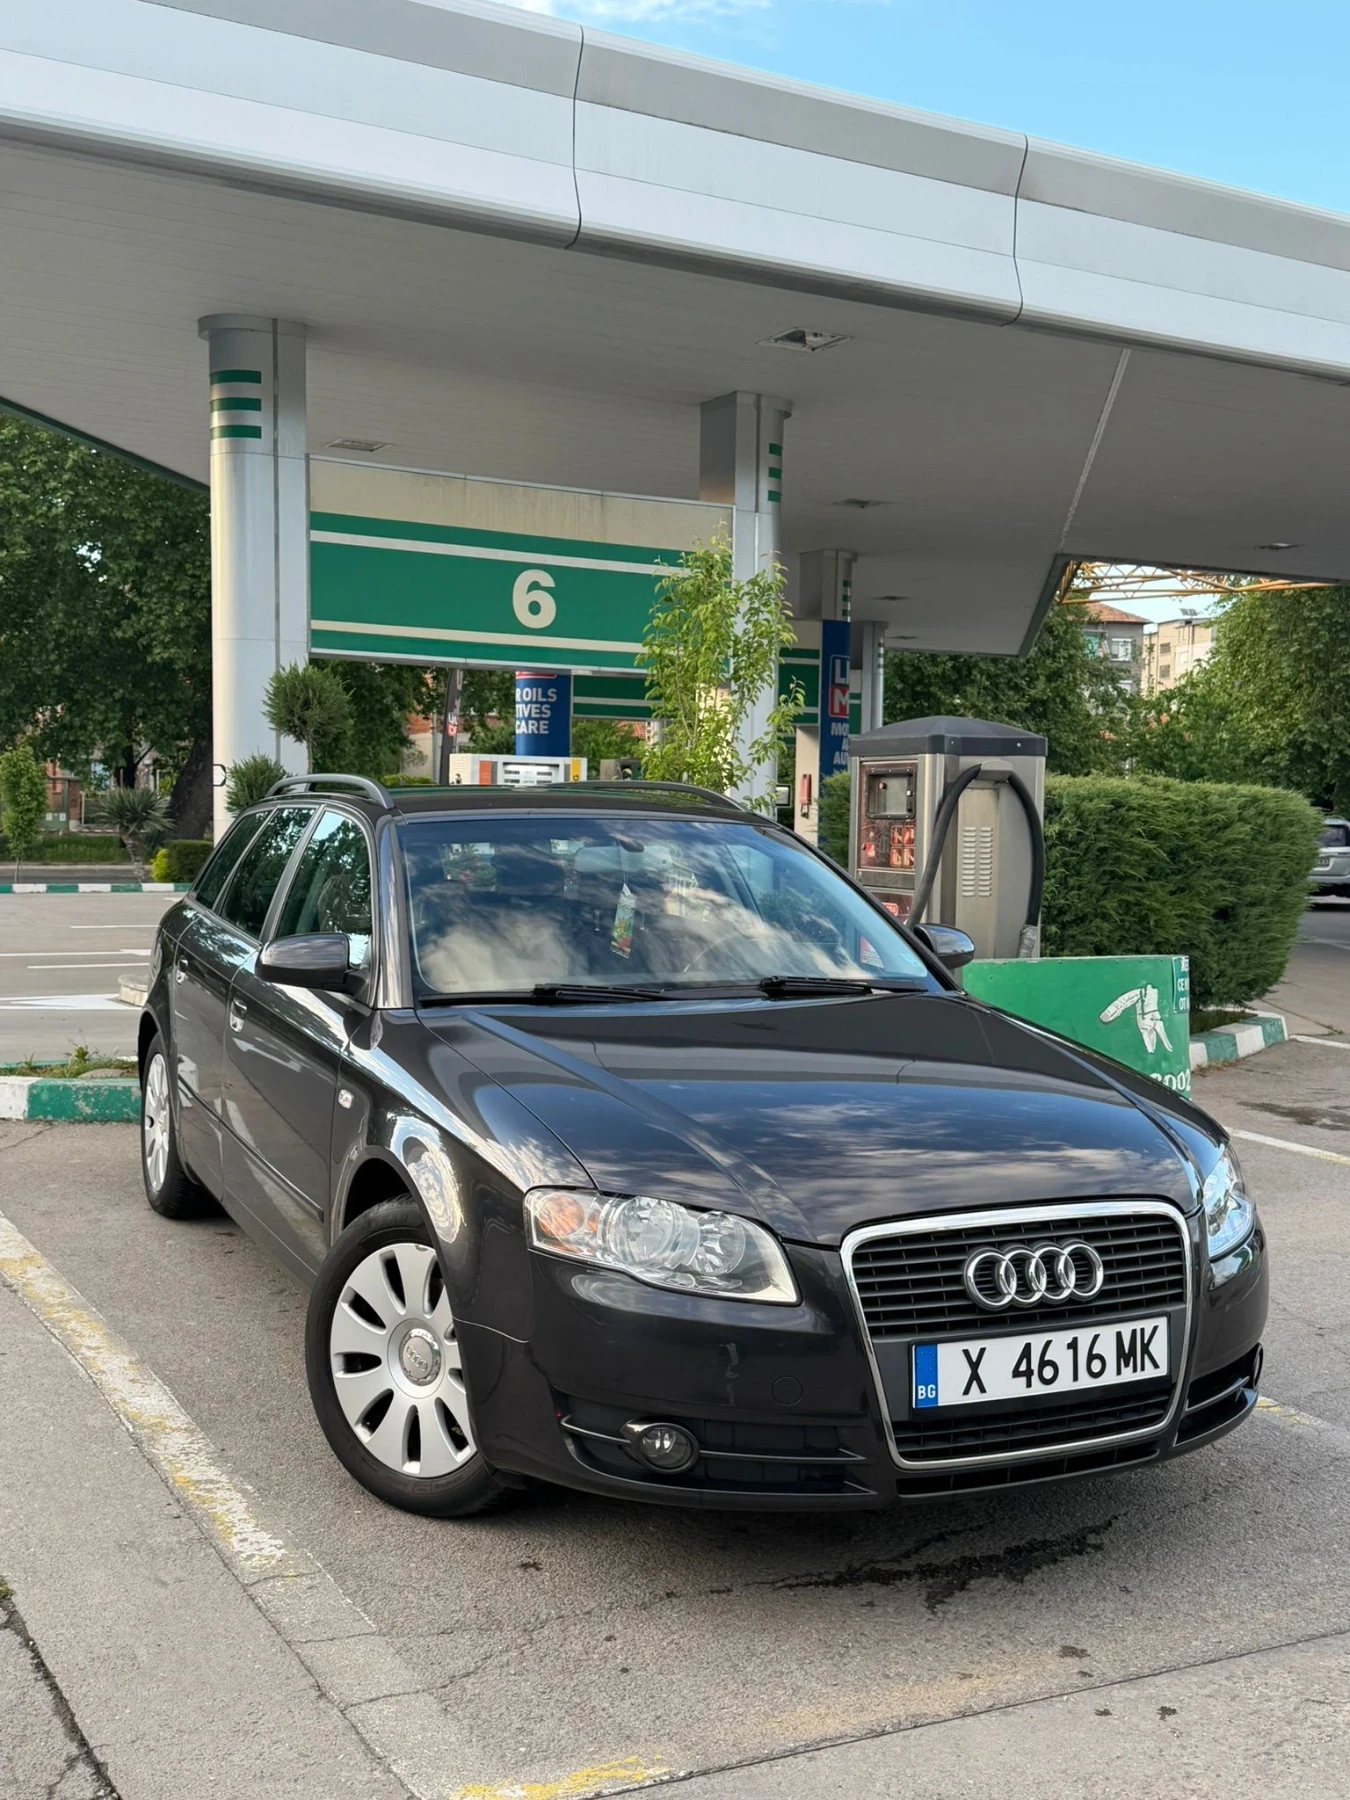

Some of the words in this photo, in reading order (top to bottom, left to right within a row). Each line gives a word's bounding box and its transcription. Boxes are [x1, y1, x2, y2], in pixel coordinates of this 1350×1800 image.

[512, 568, 557, 630] 6
[522, 687, 557, 703] OILS
[962, 1347, 987, 1396] X
[1011, 1333, 1107, 1388] 4616
[1116, 1325, 1160, 1376] MK
[917, 1384, 936, 1400] BG
